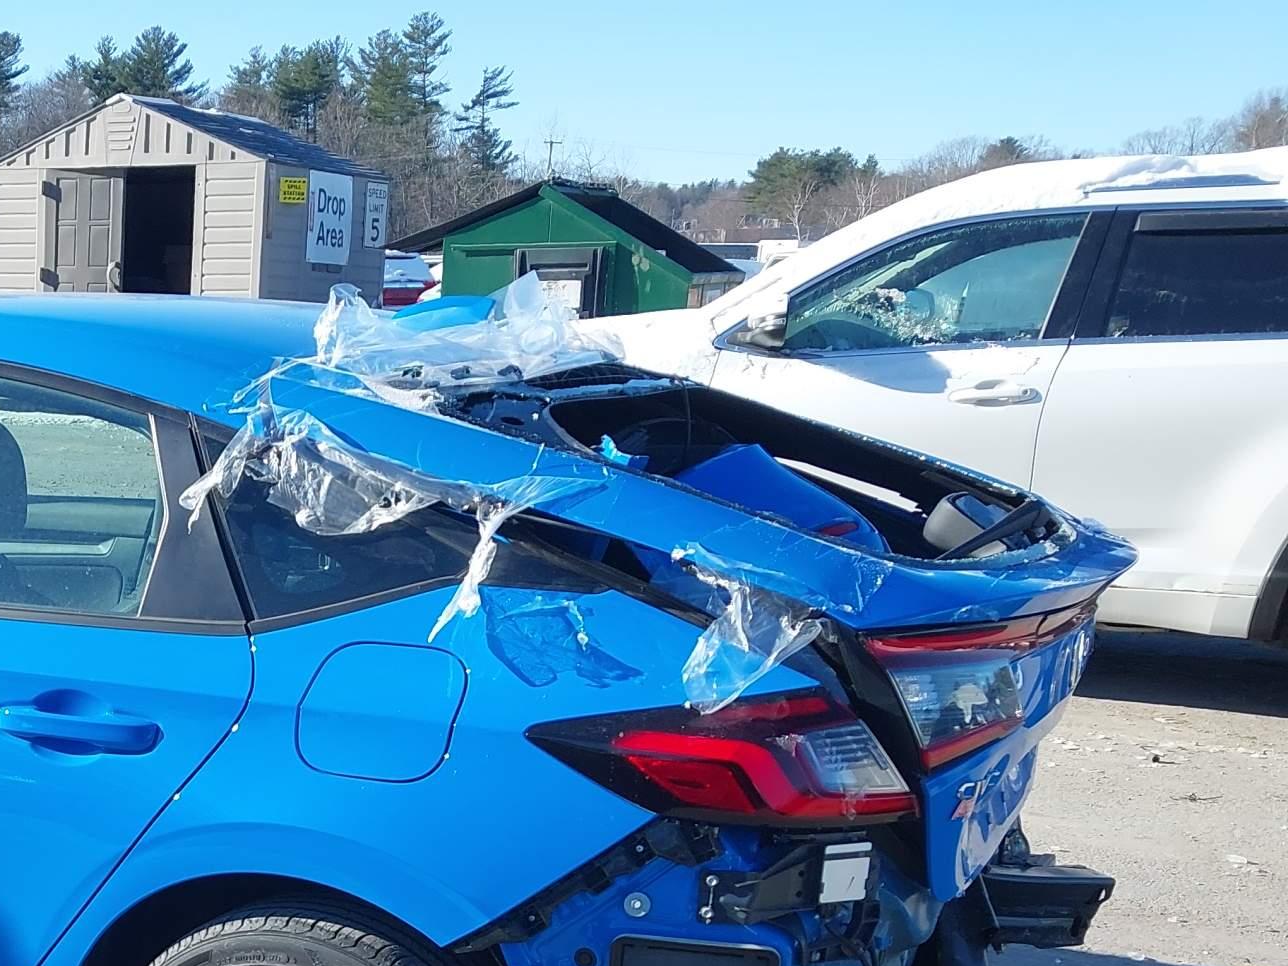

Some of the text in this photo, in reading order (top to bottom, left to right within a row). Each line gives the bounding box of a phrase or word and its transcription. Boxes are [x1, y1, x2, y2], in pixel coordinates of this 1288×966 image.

[317, 188, 346, 221] Drop
[368, 188, 387, 200] SPEED
[368, 203, 385, 214] LIMIT
[315, 220, 344, 248] Area
[370, 217, 380, 242] 5
